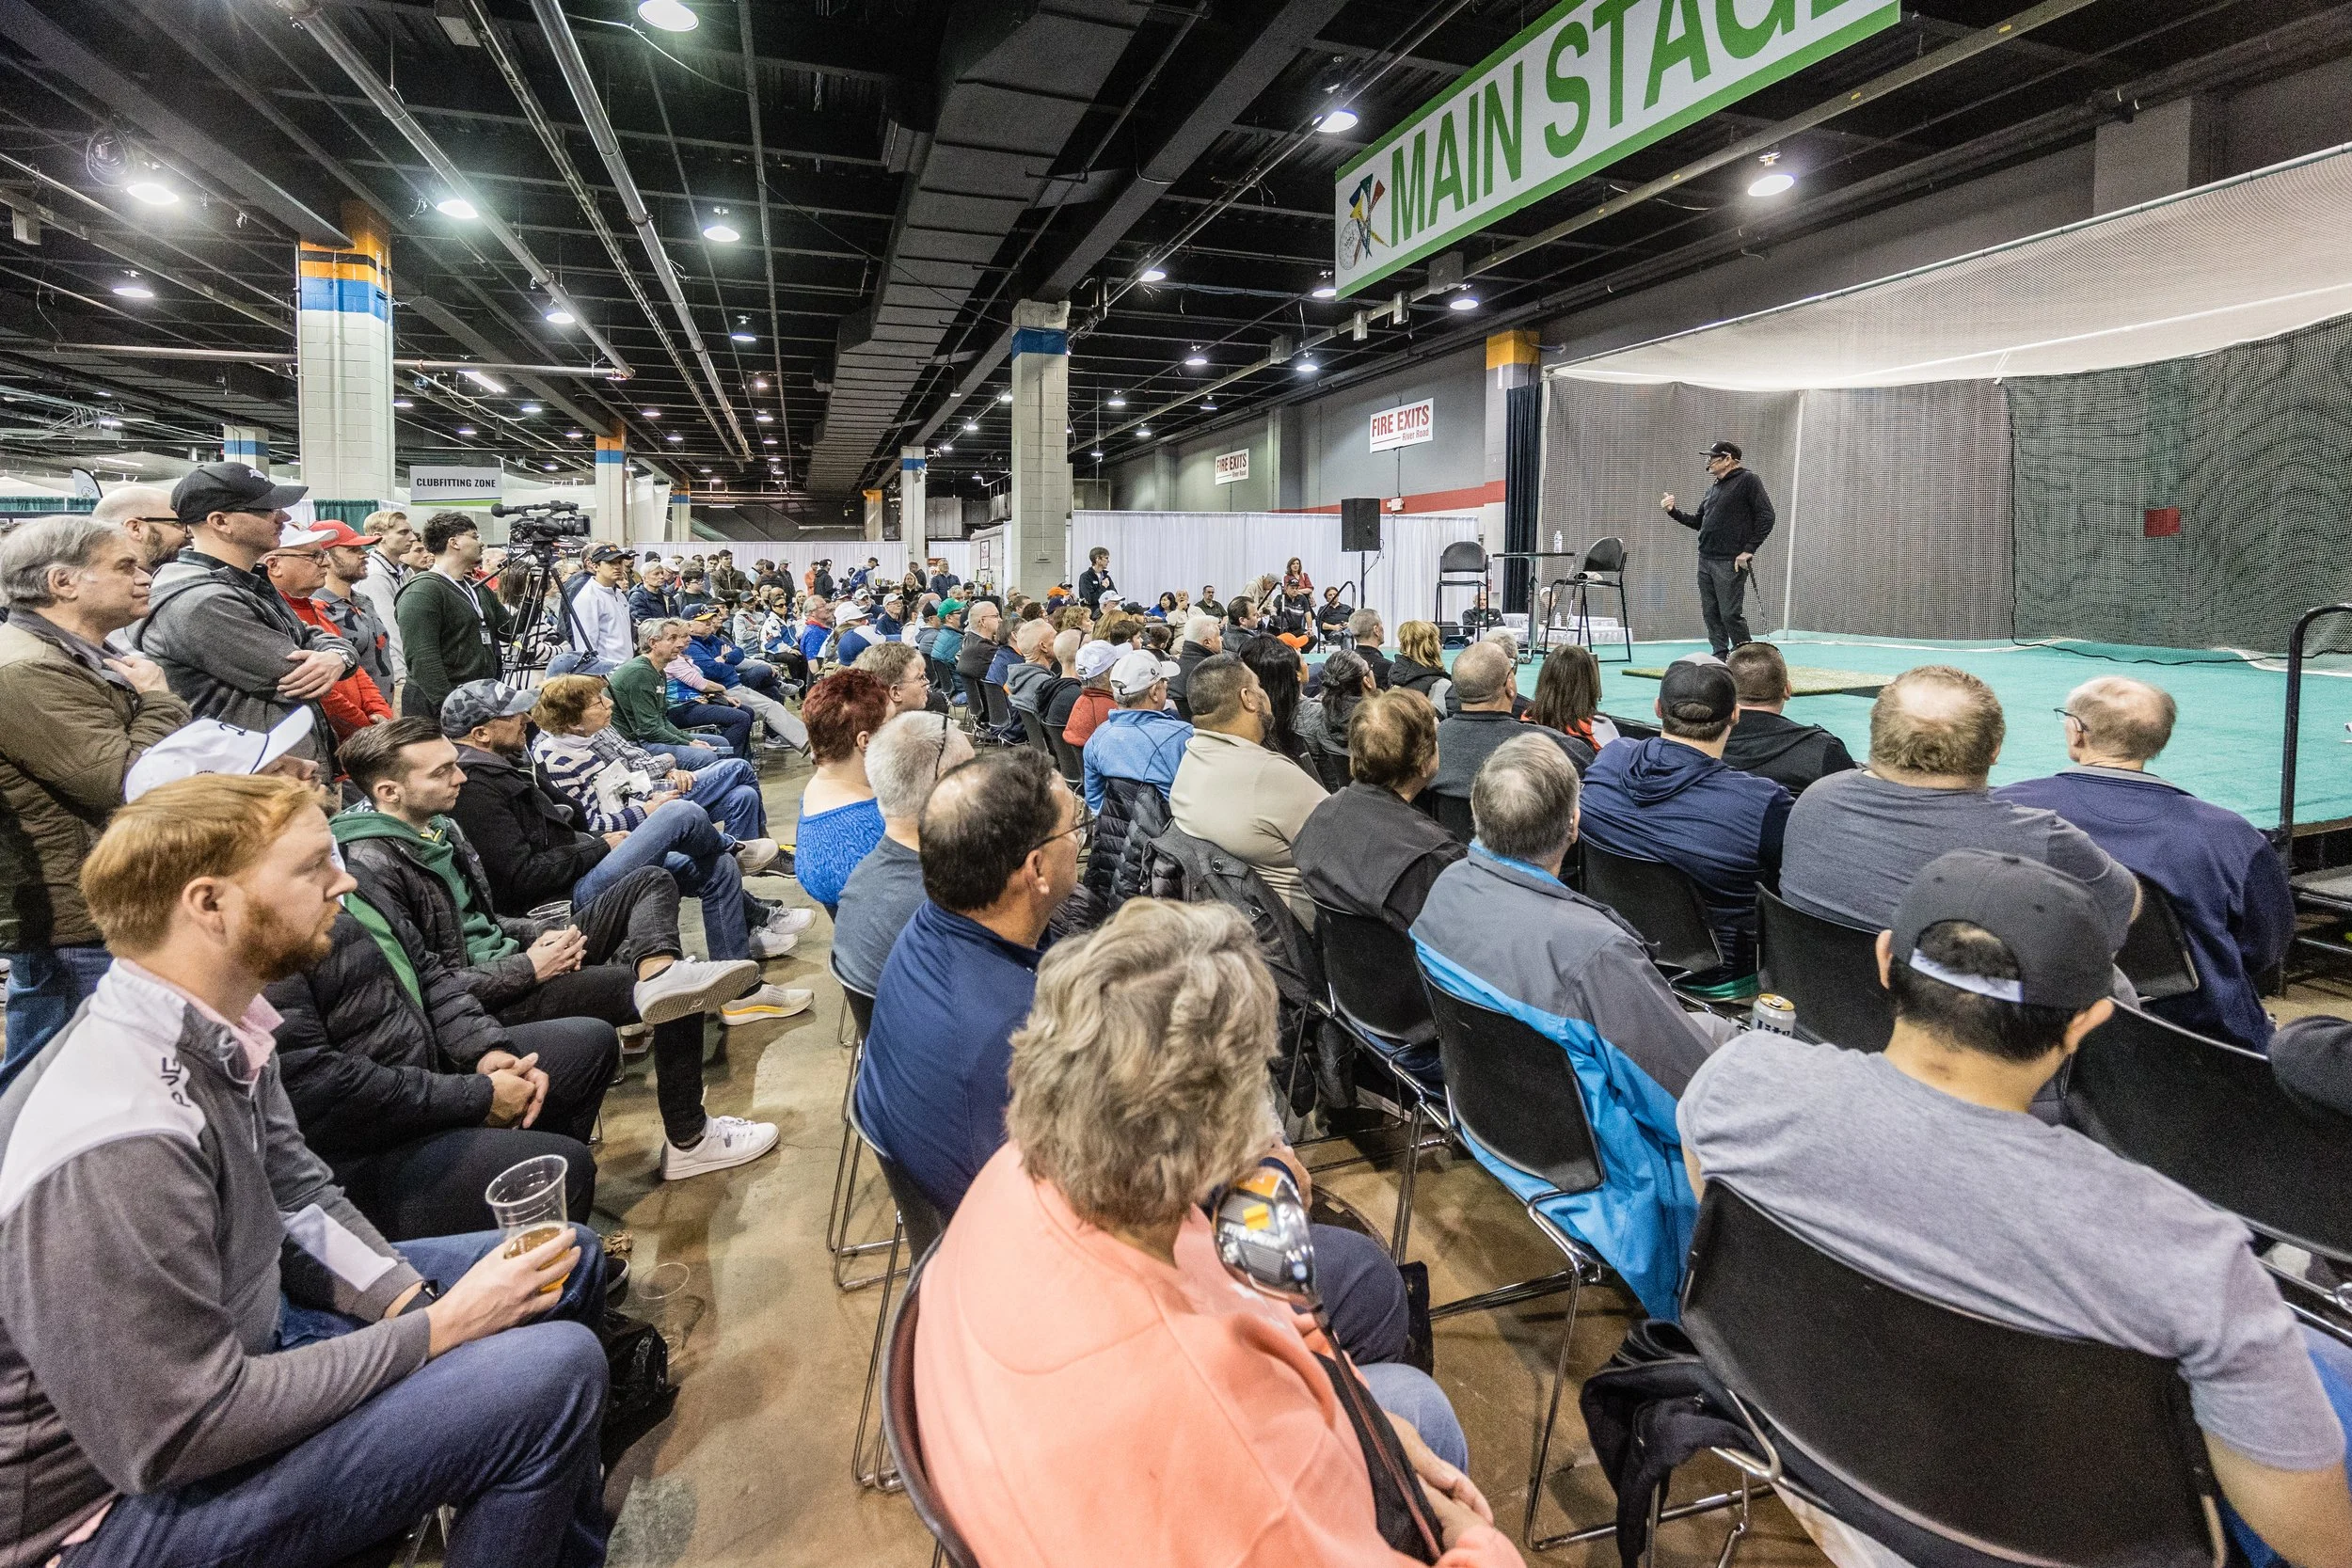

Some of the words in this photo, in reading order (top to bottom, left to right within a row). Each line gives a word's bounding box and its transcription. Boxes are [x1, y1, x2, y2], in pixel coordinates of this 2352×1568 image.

[1391, 60, 1523, 248] MAIN
[1544, 0, 1850, 158] STA
[1372, 414, 1393, 437] FIRE
[1397, 404, 1429, 432] EXITS
[1402, 432, 1415, 441] River
[1416, 428, 1429, 438] Road
[1216, 457, 1228, 473] FIRE
[1229, 453, 1247, 471] EXITS
[416, 478, 472, 487] CLUBFITTING
[474, 479, 496, 488] ZONE
